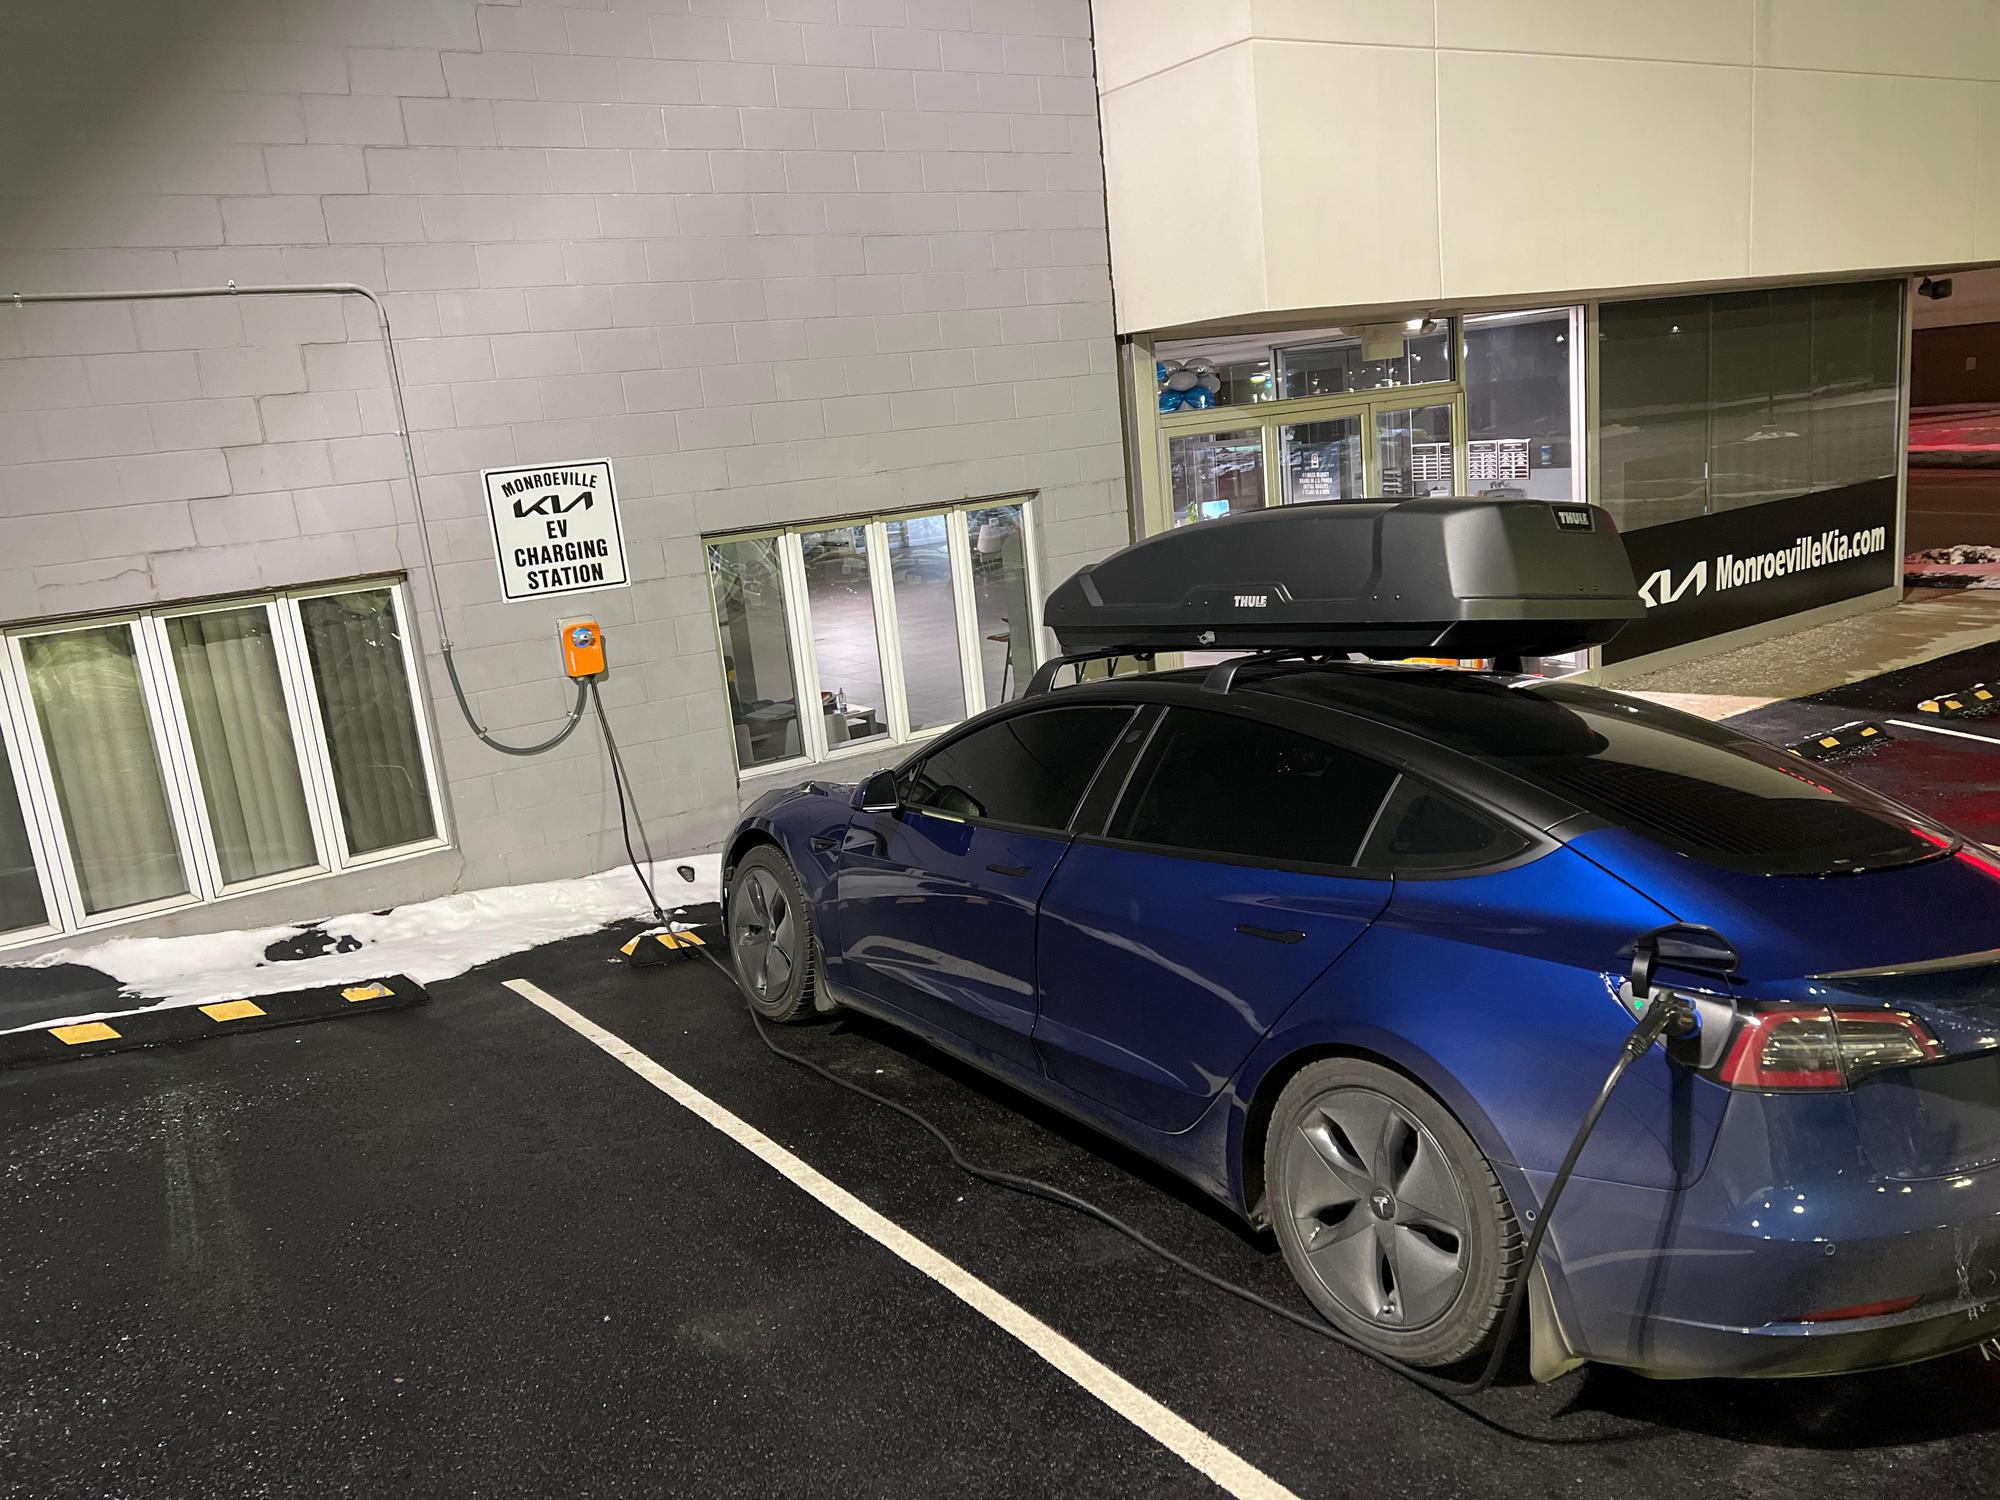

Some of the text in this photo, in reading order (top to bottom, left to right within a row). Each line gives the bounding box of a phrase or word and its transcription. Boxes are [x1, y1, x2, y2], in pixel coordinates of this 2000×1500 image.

[501, 471, 598, 498] MONROEVILLE
[546, 519, 568, 539] EV
[1558, 511, 1589, 525] THULE
[514, 539, 608, 567] CHARGING
[1715, 525, 1886, 592] MonroevilleKia.com
[527, 562, 604, 590] STATION
[1234, 595, 1268, 607] THULE
